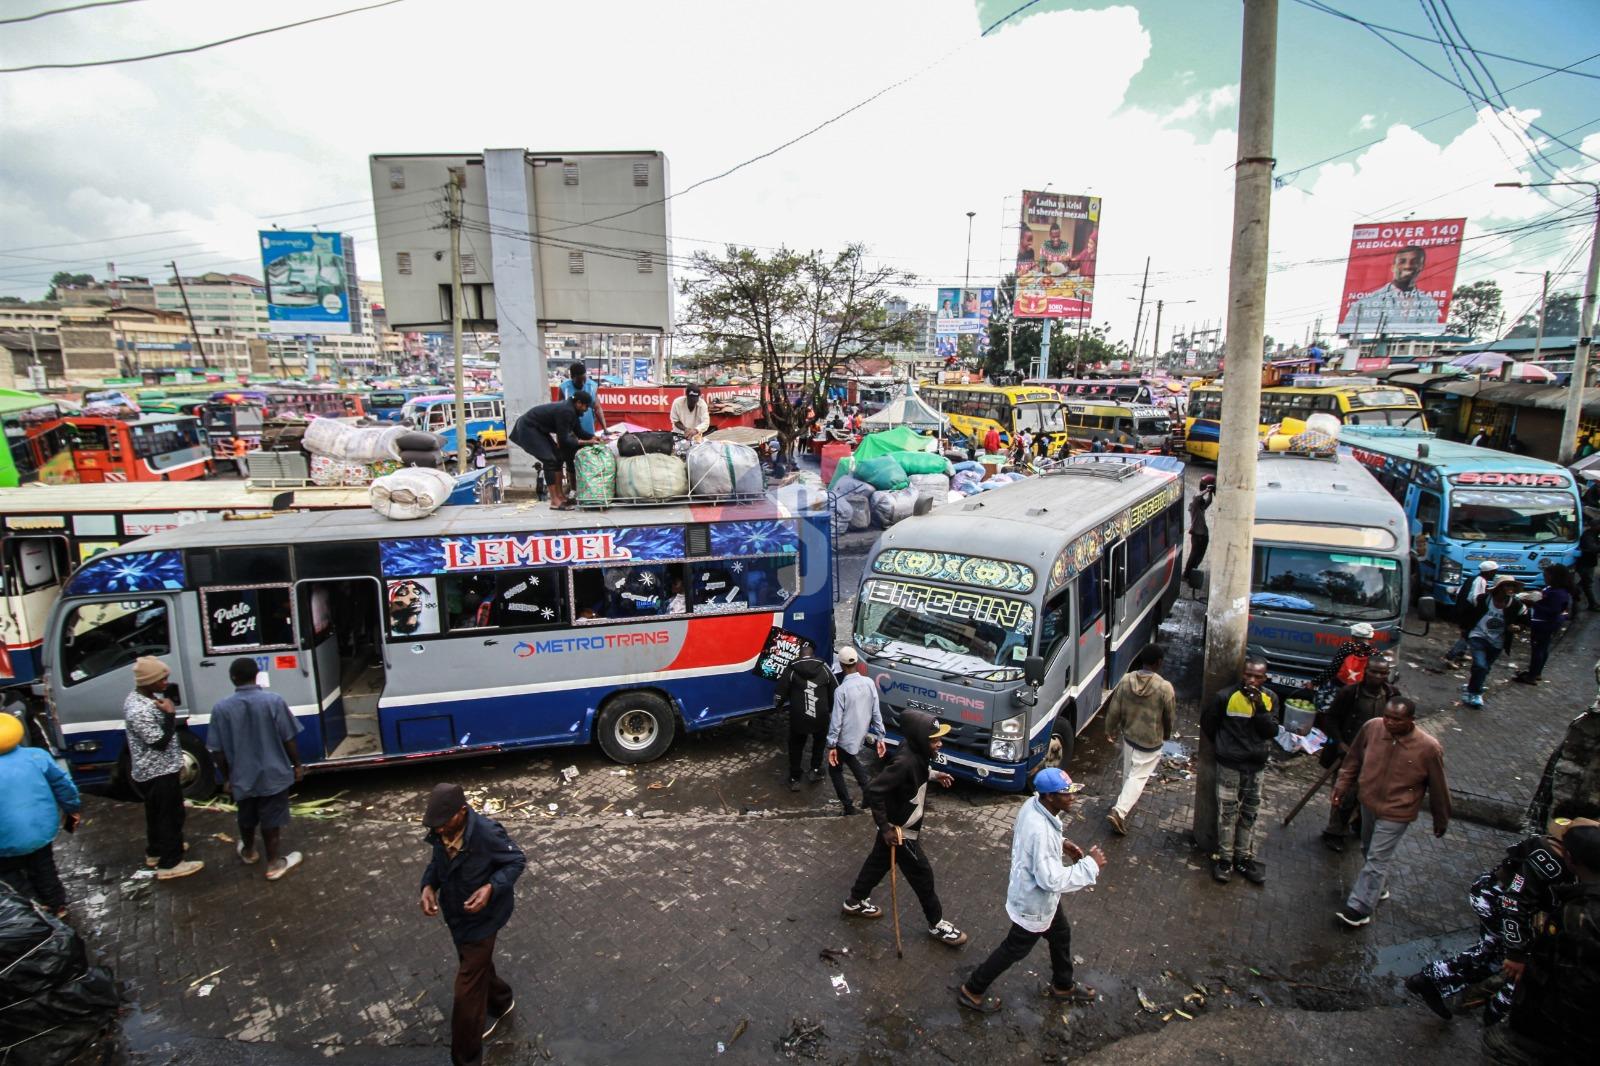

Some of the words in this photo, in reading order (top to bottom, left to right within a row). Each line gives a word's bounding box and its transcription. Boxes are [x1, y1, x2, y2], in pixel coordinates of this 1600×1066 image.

[1036, 198, 1057, 208] Ladha
[1036, 207, 1063, 218] sherehe
[1064, 211, 1088, 220] mezani
[1381, 226, 1424, 239] OVER
[1431, 224, 1459, 236] 140
[1356, 239, 1404, 249] MEDICAL
[1407, 236, 1457, 247] CENTRES
[1378, 290, 1448, 299] HEALTHCARE
[1413, 300, 1446, 308] HOME
[1400, 309, 1443, 317] KENYA
[629, 394, 669, 406] KIOSK
[1457, 472, 1563, 486] SONIA
[441, 533, 632, 570] LEMUEL
[869, 578, 1024, 629] BITCOIN
[213, 601, 252, 625] Pablo
[229, 615, 257, 637] 254
[536, 630, 670, 655] METROTRANS
[765, 658, 788, 675] BETT
